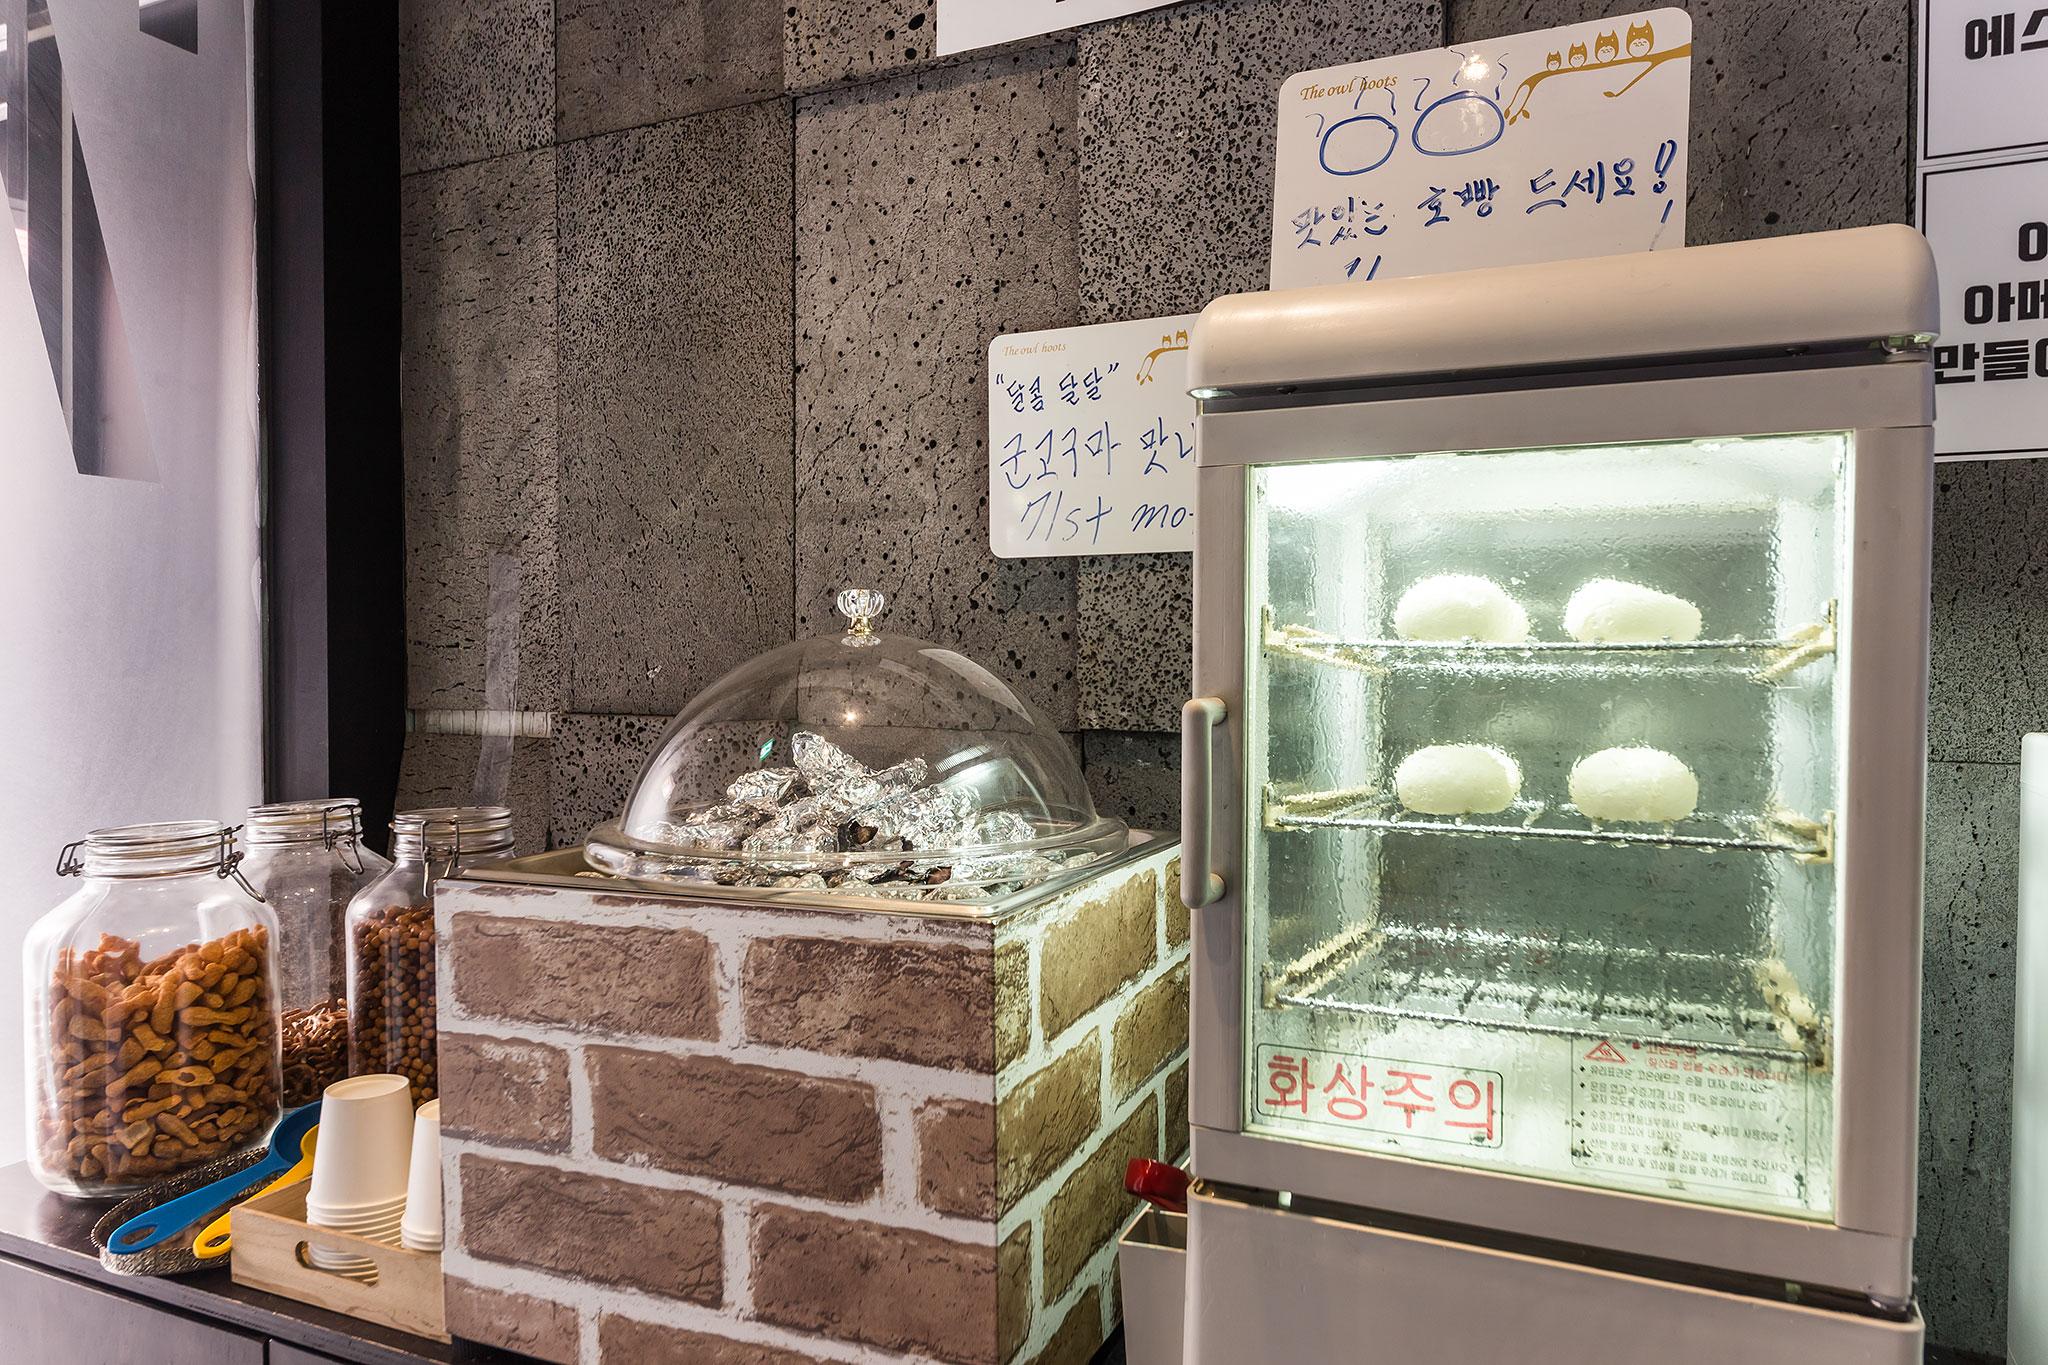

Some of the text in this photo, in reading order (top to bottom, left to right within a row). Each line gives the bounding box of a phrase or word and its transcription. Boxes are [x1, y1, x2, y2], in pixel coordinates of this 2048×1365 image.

[1301, 84, 1325, 100] The
[1327, 79, 1356, 96] owl
[1417, 177, 1500, 227] 호빵
[1002, 341, 1067, 357] The owl hoots
[1934, 337, 2048, 384] 만들
[1000, 421, 1121, 489] 군고구마
[1265, 1055, 1494, 1140] 화상주의
